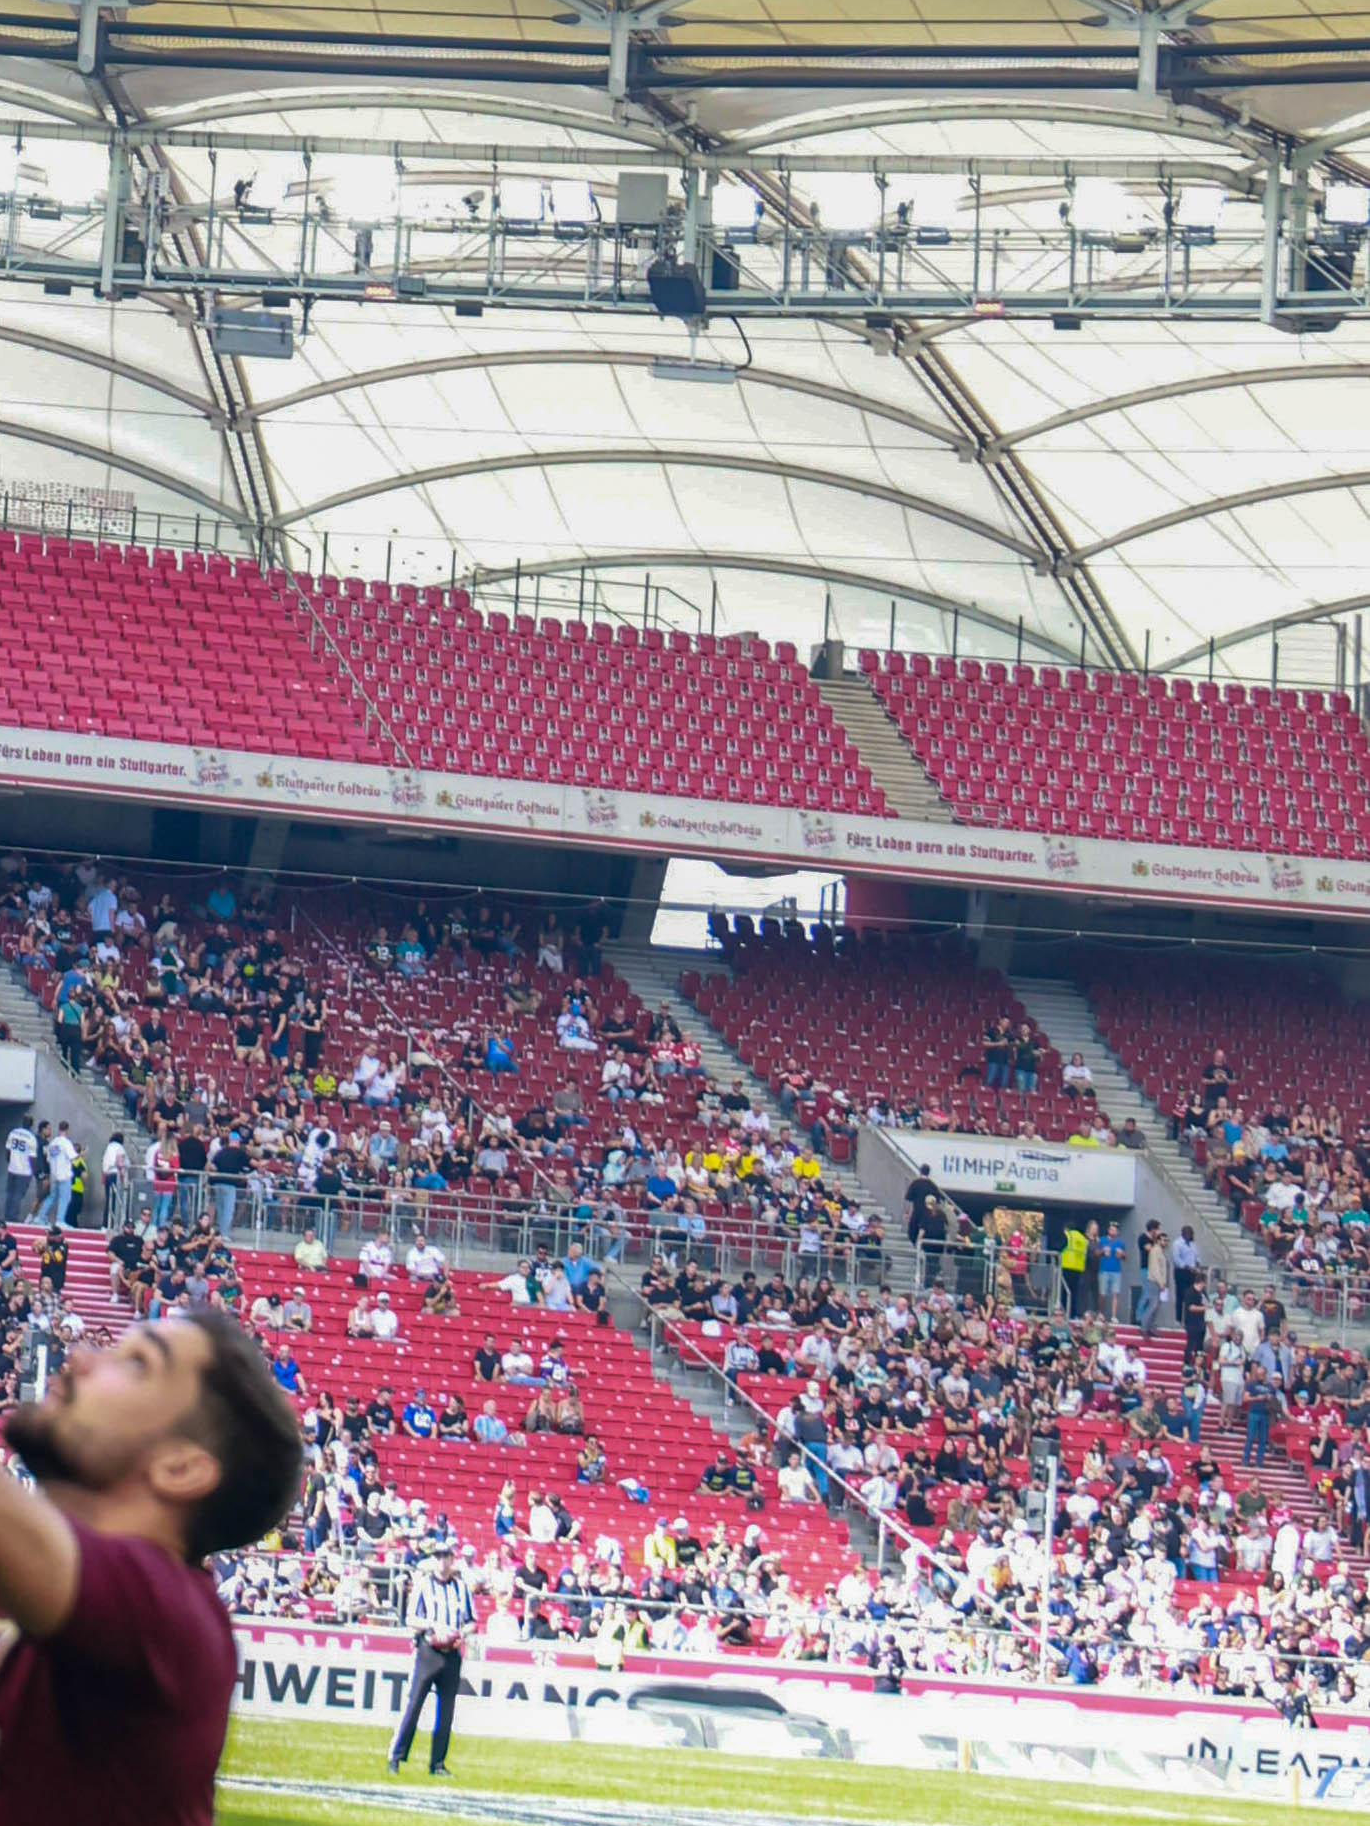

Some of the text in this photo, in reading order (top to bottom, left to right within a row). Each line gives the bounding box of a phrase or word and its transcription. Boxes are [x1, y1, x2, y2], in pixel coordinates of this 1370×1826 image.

[25, 746, 62, 765] Leben
[65, 752, 93, 769] gern
[96, 753, 116, 769] ein
[119, 757, 187, 777] Stuttgarter.
[876, 835, 912, 853] Leben
[916, 841, 943, 858] gern
[970, 844, 1037, 865] Stuttgarter.
[963, 1159, 1059, 1182] MHP Arena
